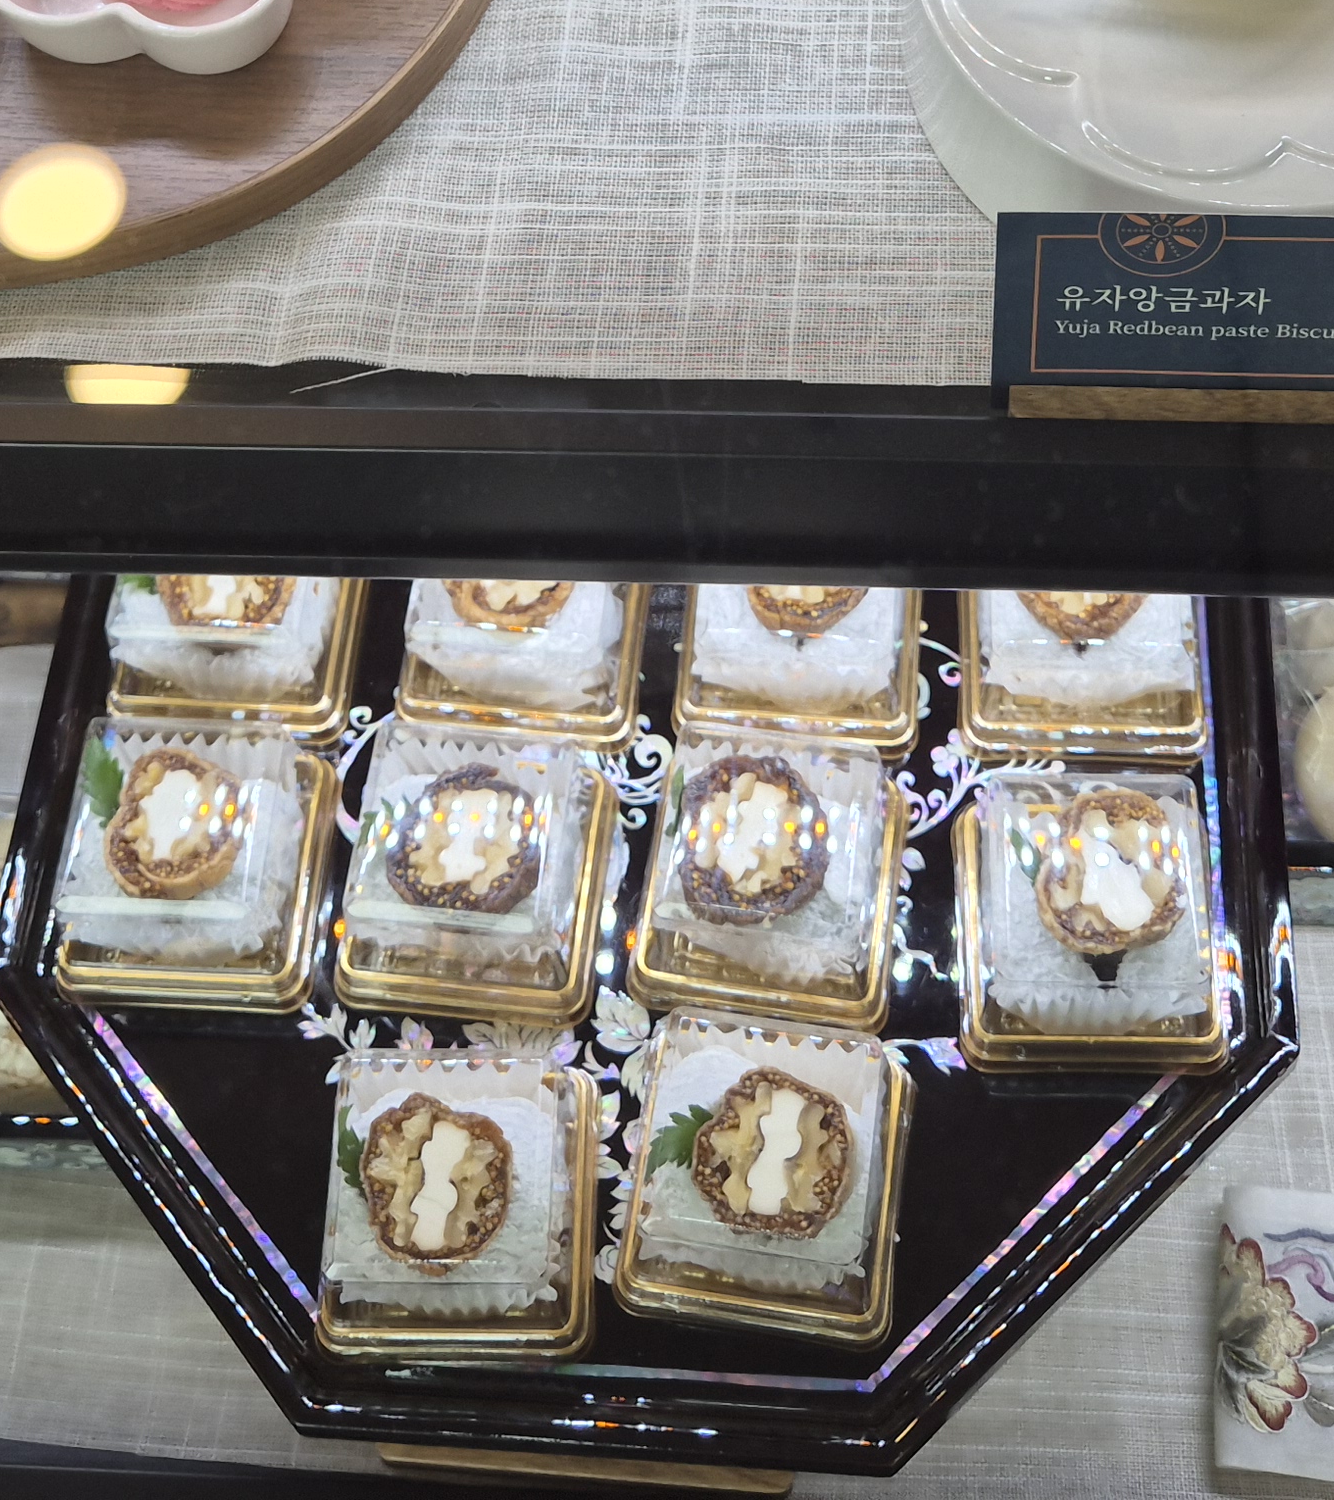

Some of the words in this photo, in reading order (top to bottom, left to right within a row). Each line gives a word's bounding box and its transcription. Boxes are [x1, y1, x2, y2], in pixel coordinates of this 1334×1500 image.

[1055, 285, 1272, 315] 유자앙금과자
[1054, 319, 1100, 338] Yuja
[1107, 320, 1204, 337] Redbean
[1210, 324, 1269, 341] paste
